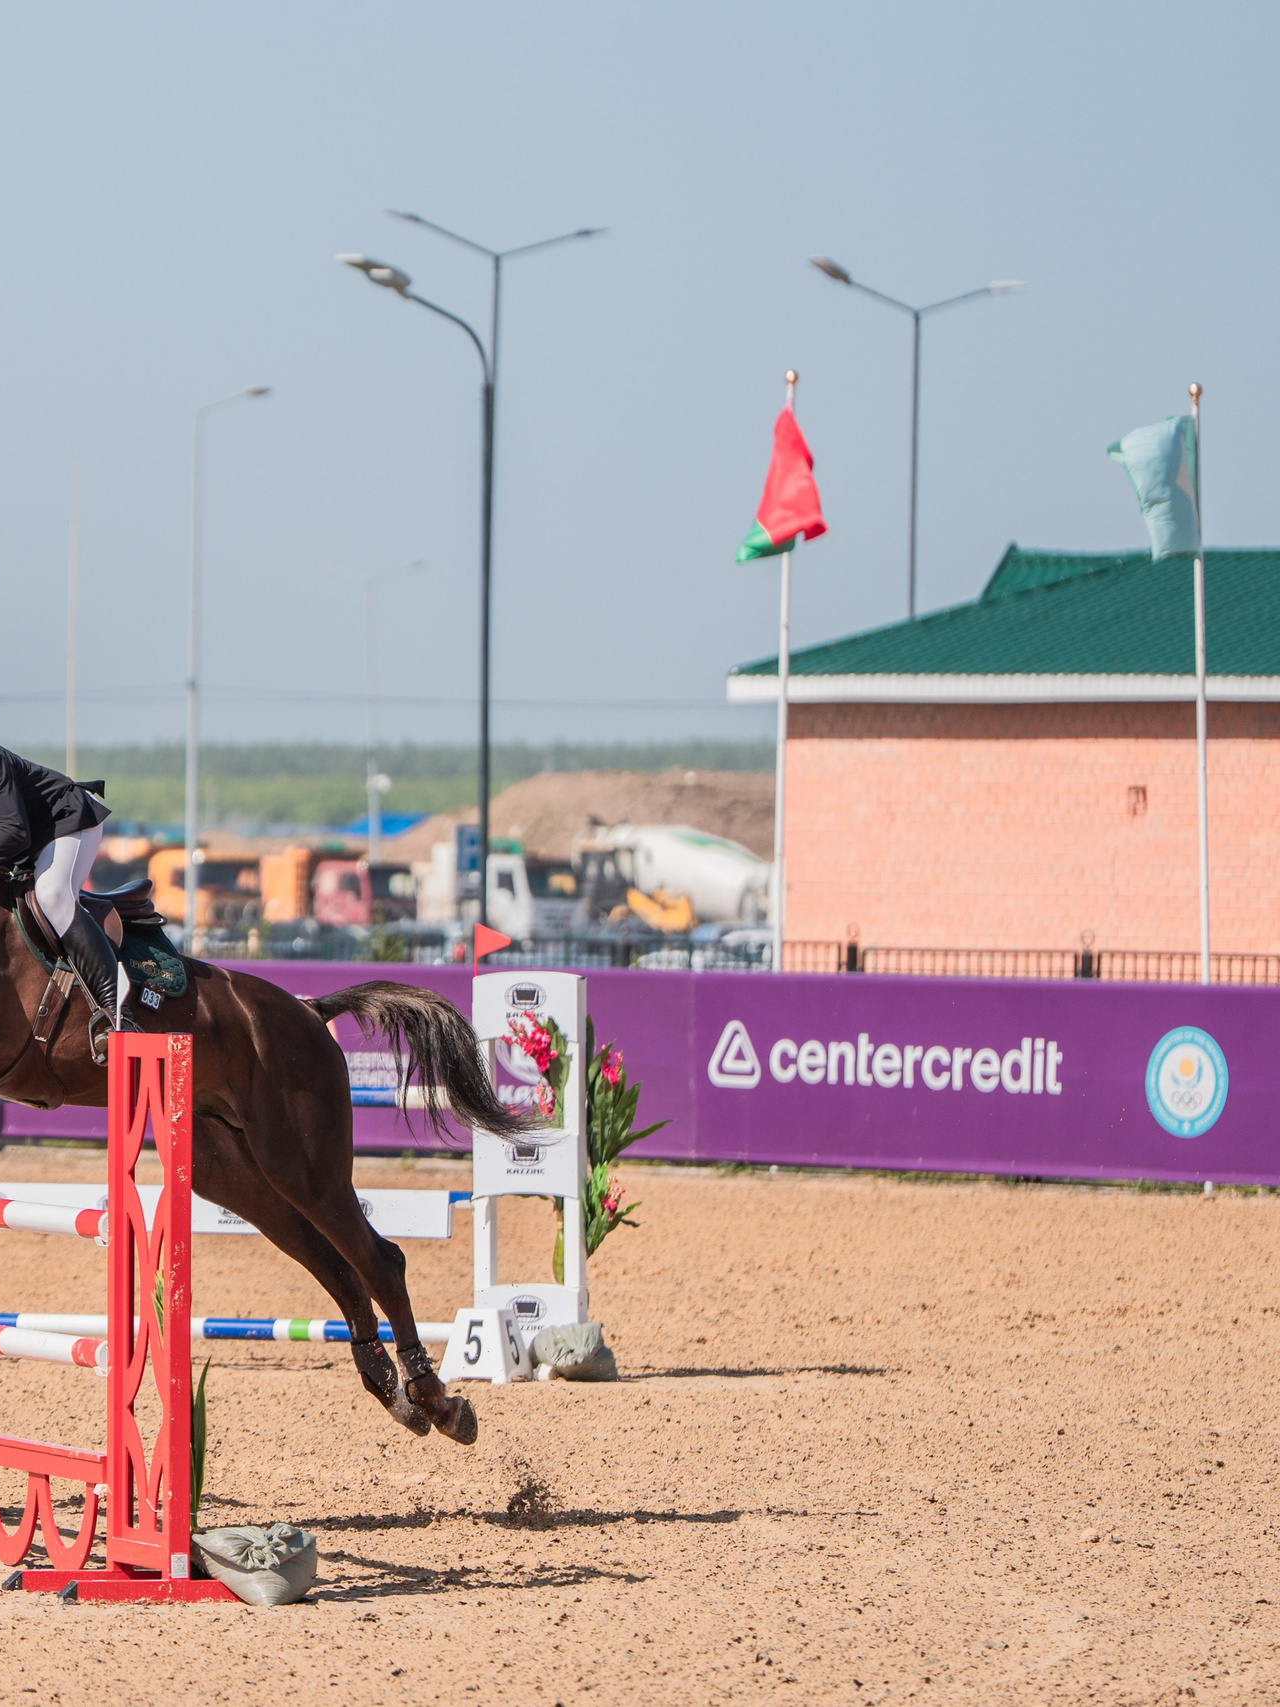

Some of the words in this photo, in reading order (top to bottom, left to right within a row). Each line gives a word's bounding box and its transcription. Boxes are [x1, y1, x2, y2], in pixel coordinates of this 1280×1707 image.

[769, 1032, 1063, 1095] centercredit
[463, 1319, 484, 1365] 5
[505, 1319, 520, 1366] 5
